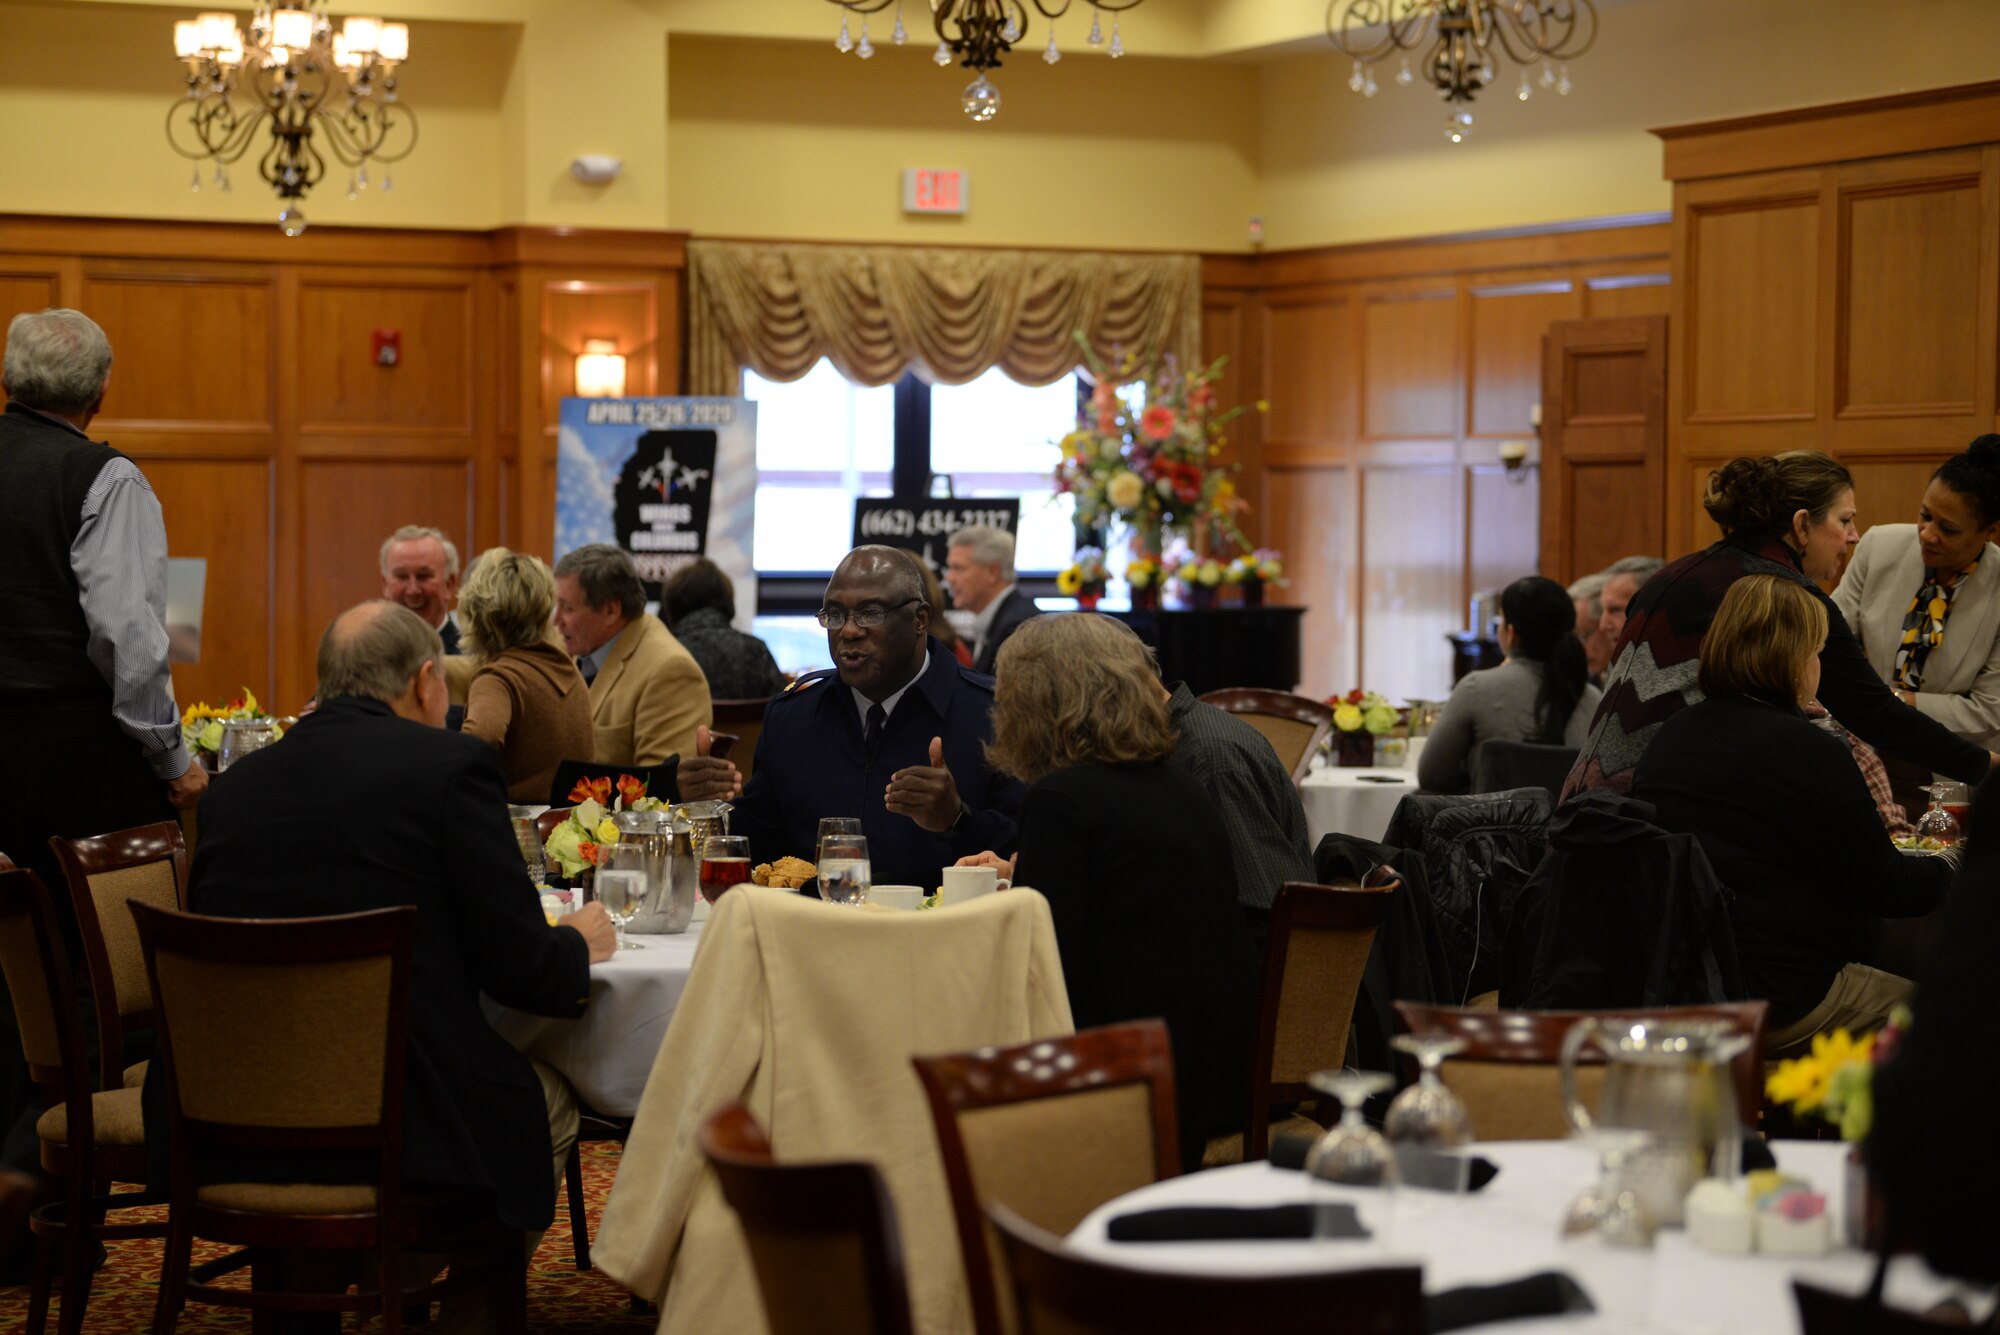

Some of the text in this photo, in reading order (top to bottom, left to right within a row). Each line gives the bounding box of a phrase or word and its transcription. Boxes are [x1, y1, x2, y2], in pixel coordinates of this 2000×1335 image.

[914, 169, 961, 210] EXIT
[587, 402, 633, 425] APRIL
[690, 402, 734, 425] 2020
[861, 508, 915, 538] (662)
